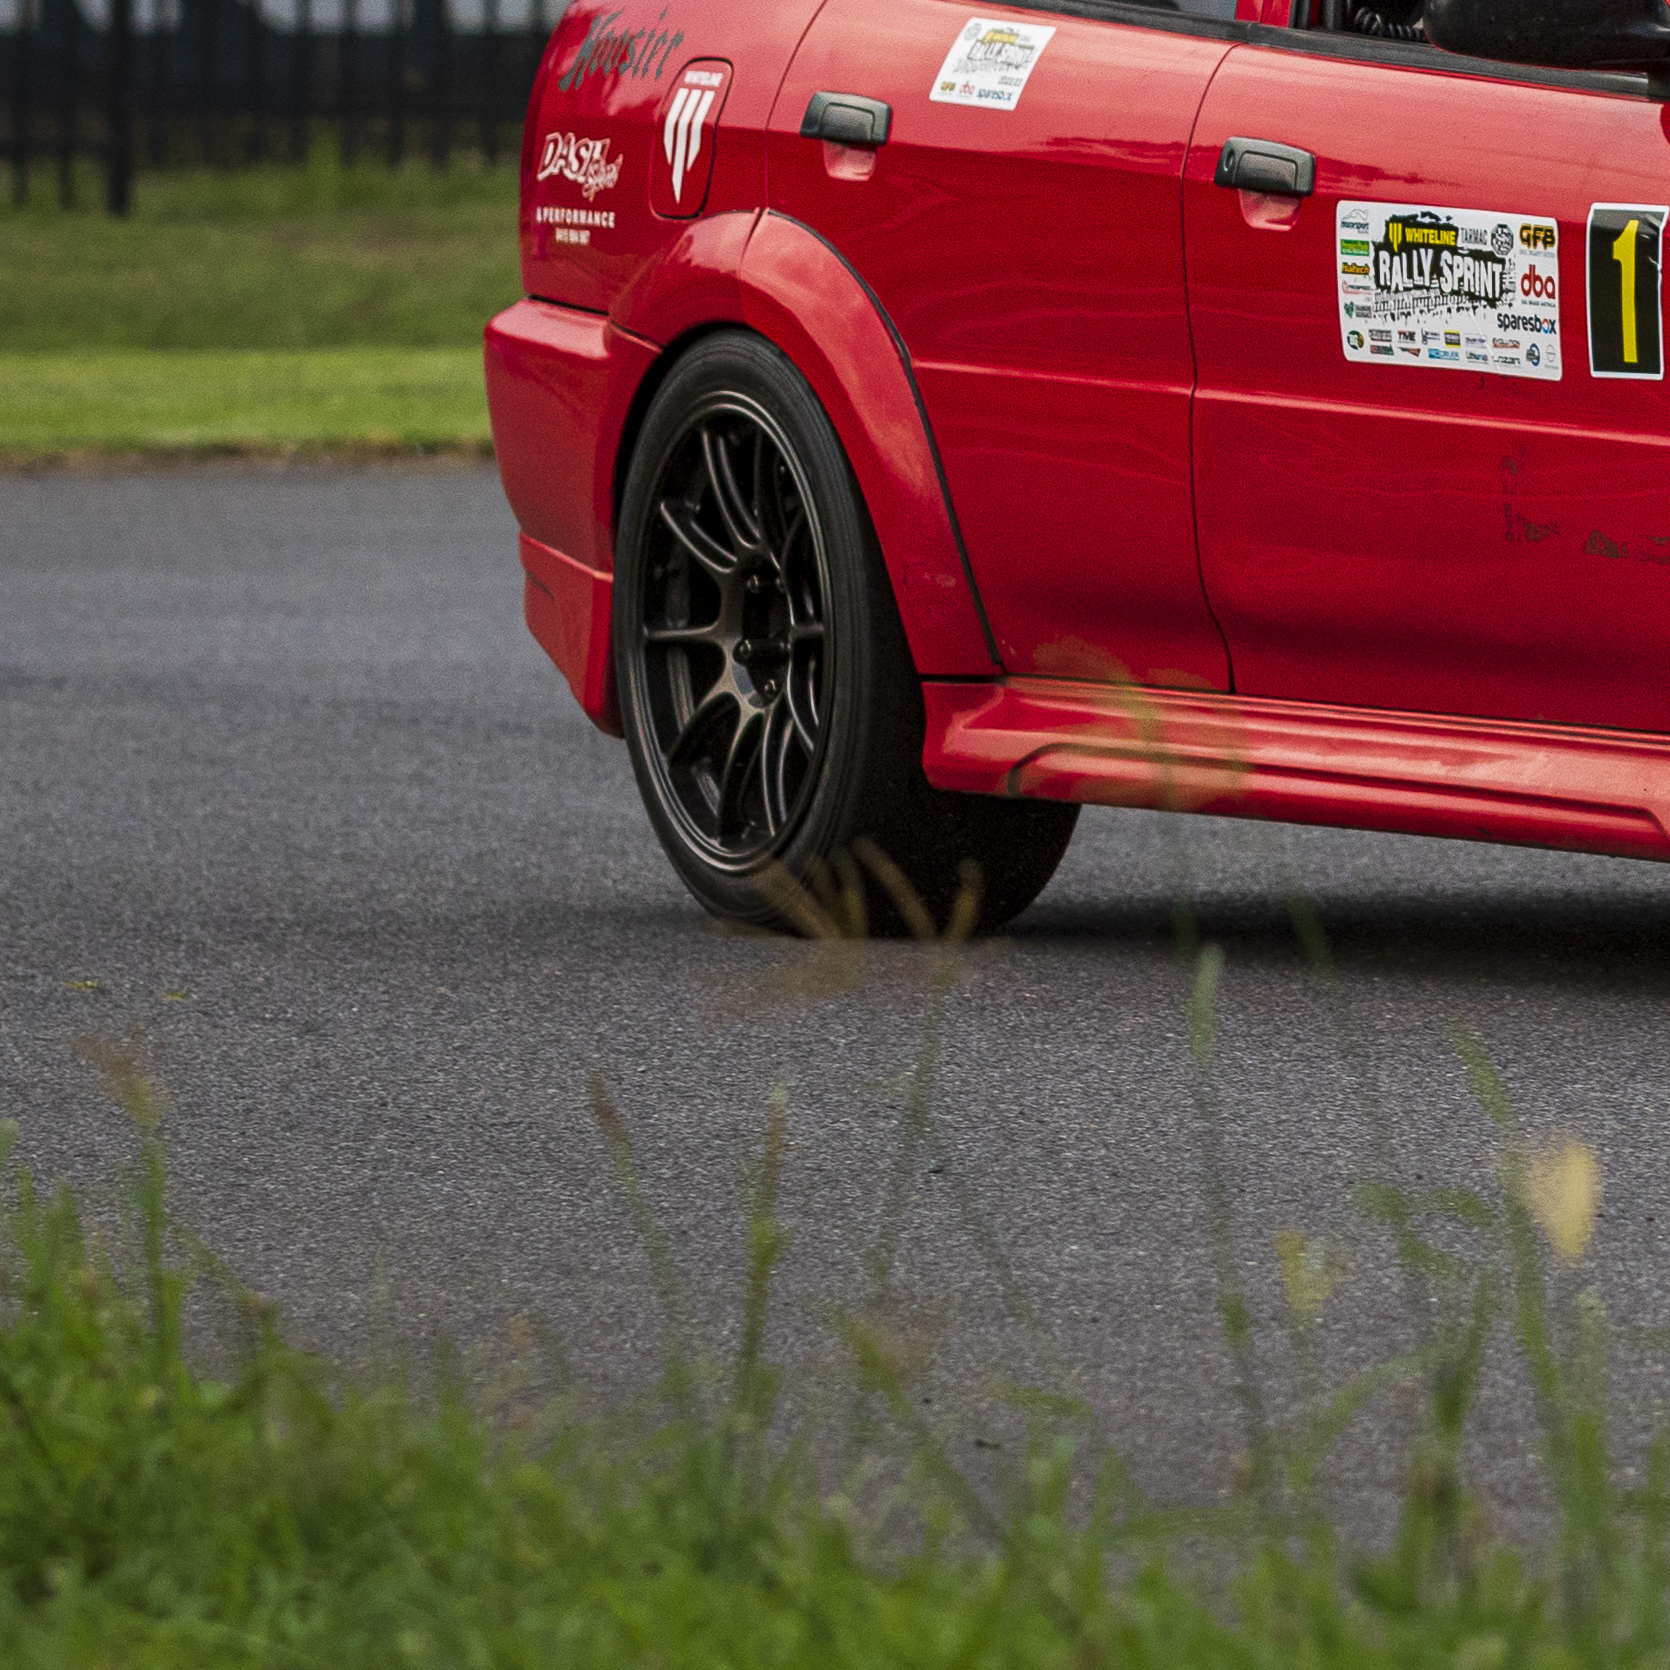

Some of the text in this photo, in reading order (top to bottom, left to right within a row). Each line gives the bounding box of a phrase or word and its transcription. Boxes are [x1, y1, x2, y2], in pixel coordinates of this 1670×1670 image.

[558, 6, 685, 93] Hoosier
[537, 132, 611, 184] DASH
[1404, 226, 1457, 246] WHITELINE
[1460, 226, 1488, 246] TARMAC
[1519, 222, 1556, 250] GFB
[1379, 247, 1505, 299] RALLY SPRINT
[1520, 263, 1556, 300] dba
[1612, 219, 1639, 364] 1
[1496, 312, 1558, 335] sparesbox
